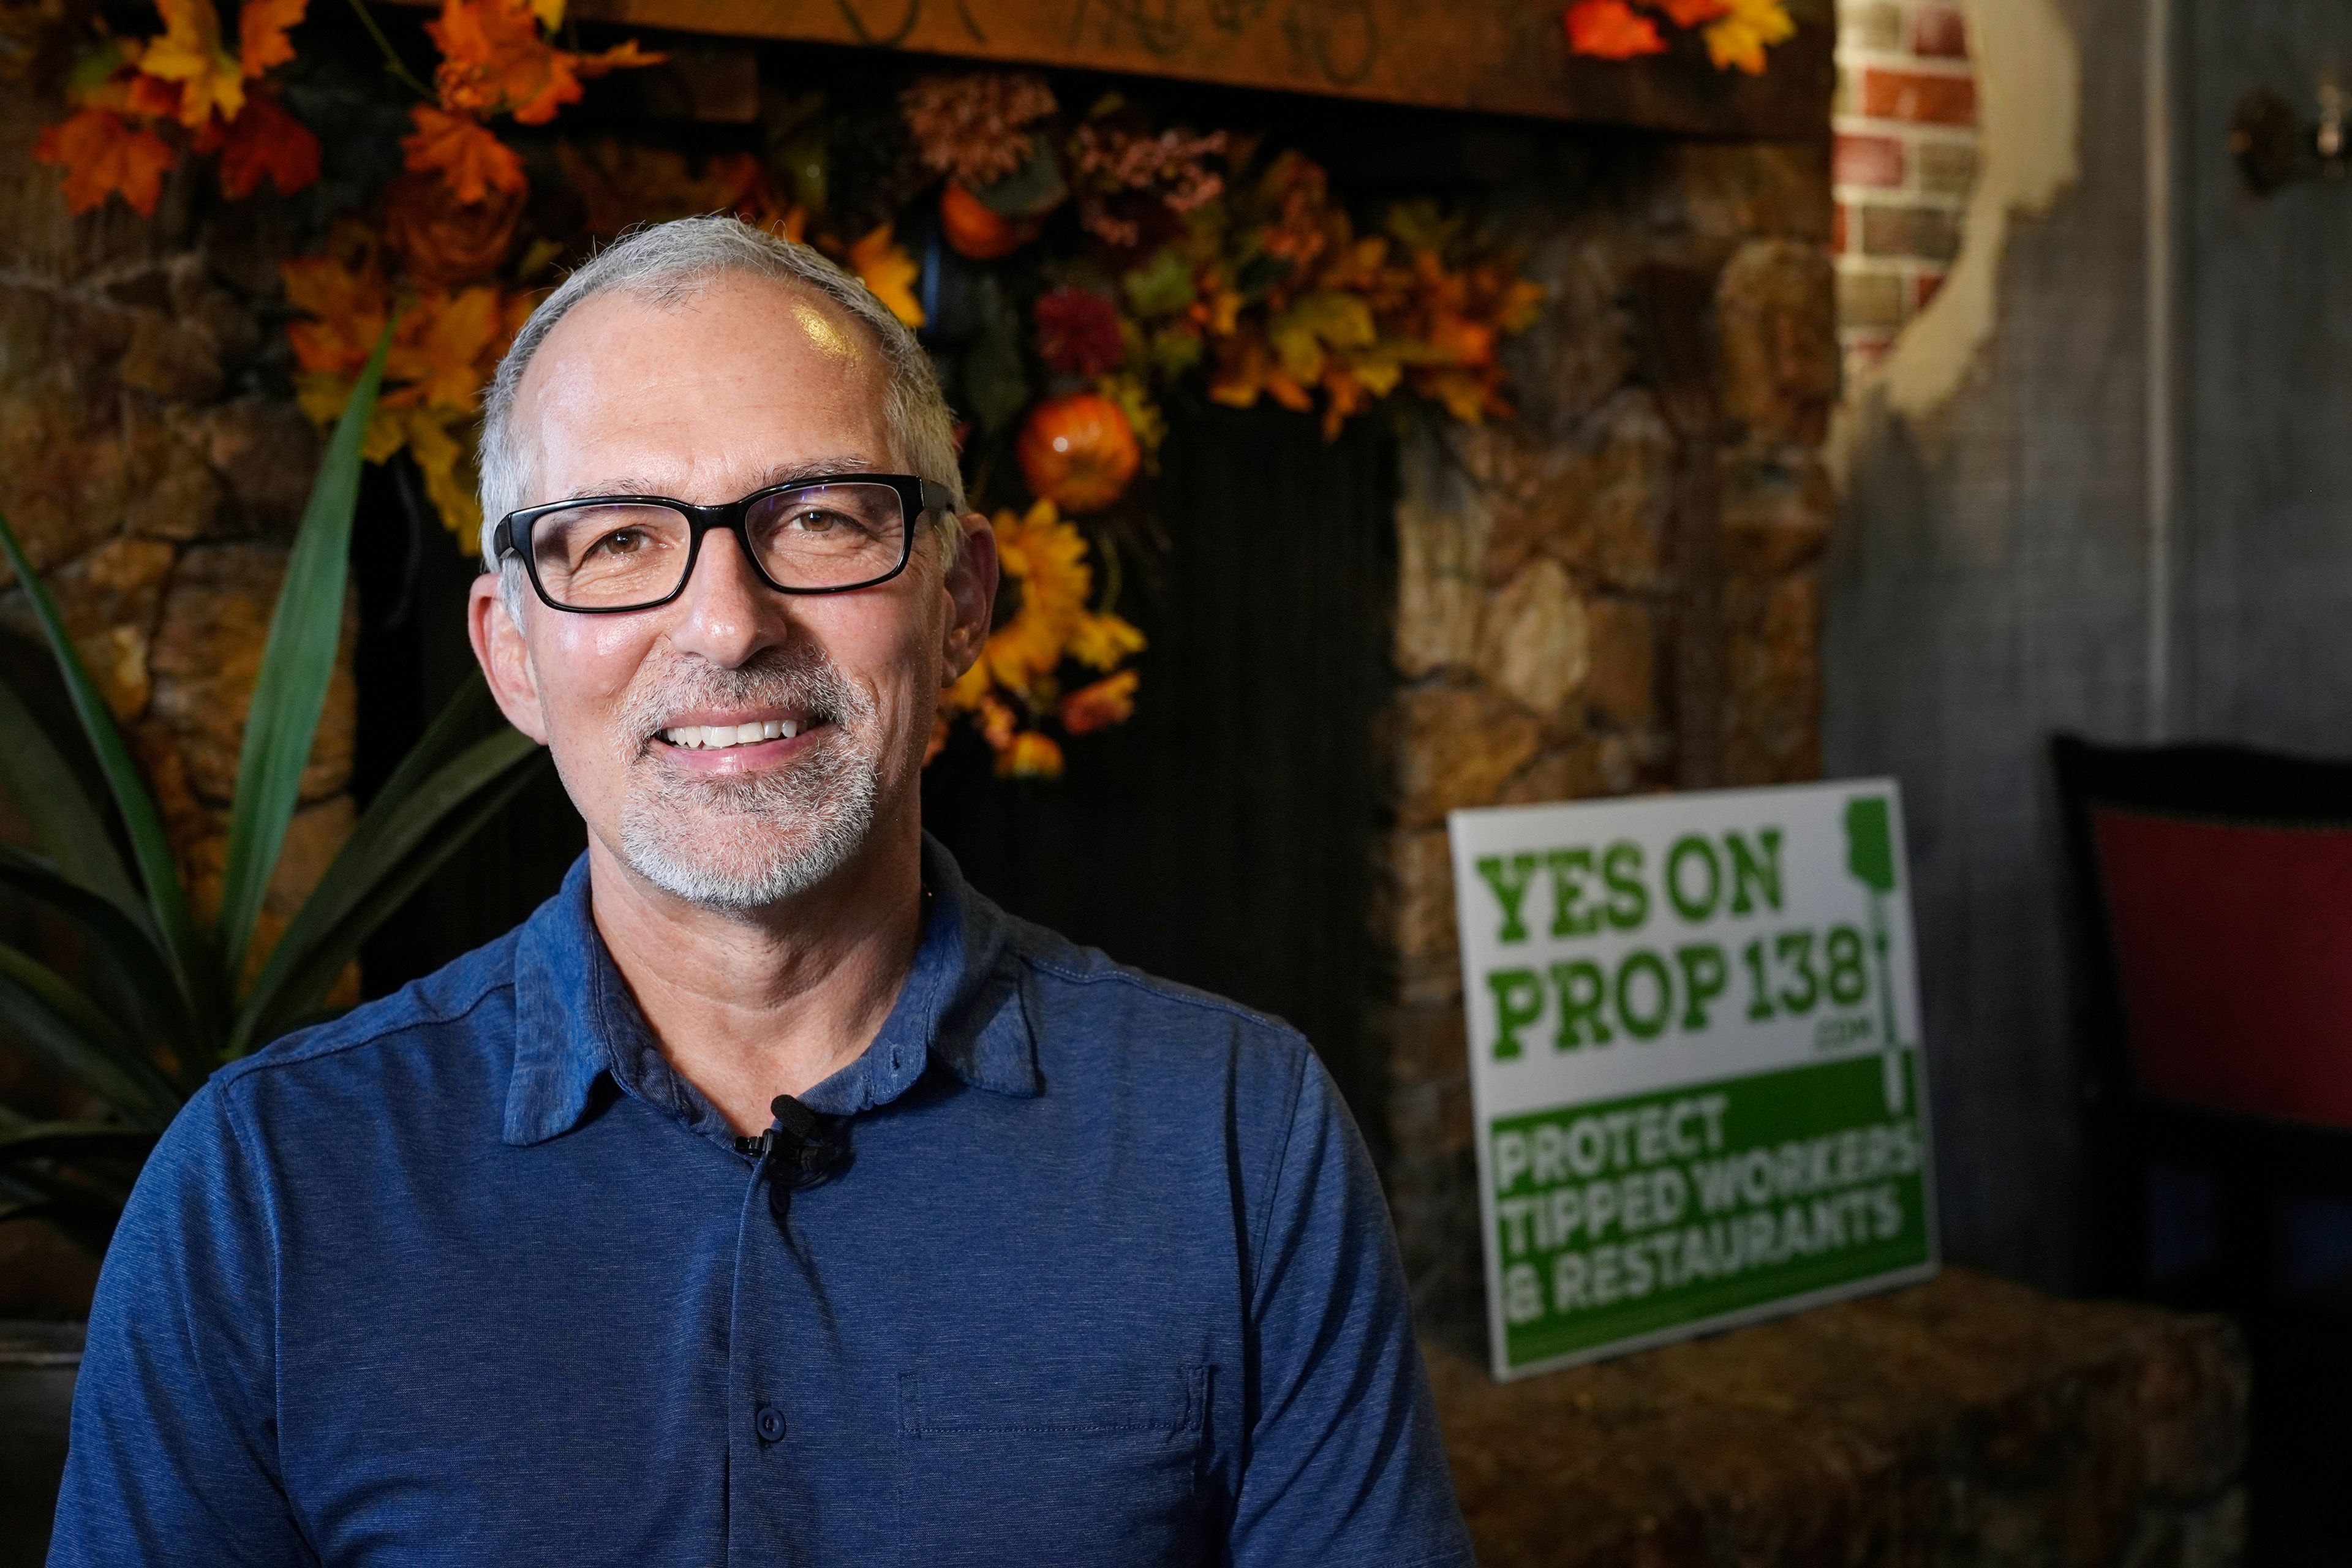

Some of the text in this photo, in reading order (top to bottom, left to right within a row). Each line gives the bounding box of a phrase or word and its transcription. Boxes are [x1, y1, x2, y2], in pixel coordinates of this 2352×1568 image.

[1477, 829, 1784, 943] YES ON
[1487, 925, 1869, 1061] PROP 138
[1497, 1096, 1728, 1189] PROTECT
[1500, 1126, 1920, 1257] TIPPED WORKERS
[1504, 1264, 1545, 1323] &
[1556, 1187, 1902, 1312] RESTAURANTS
